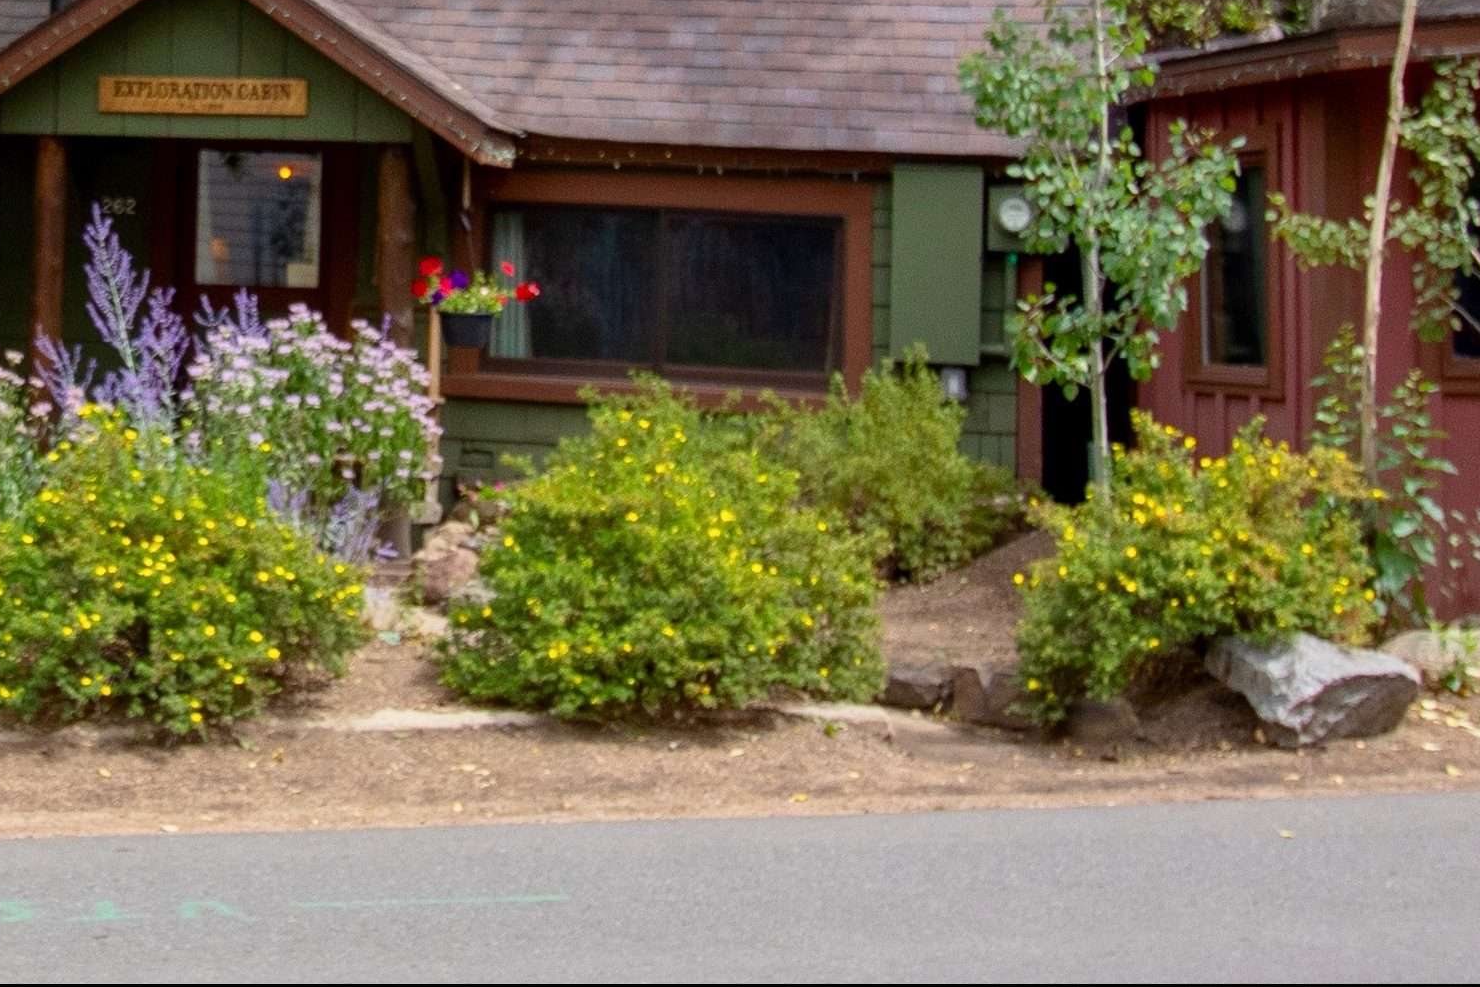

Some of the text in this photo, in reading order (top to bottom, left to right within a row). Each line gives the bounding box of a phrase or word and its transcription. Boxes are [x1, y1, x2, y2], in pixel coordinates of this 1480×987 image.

[113, 80, 291, 101] EXPLORATION CABIN
[103, 198, 137, 214] 262
